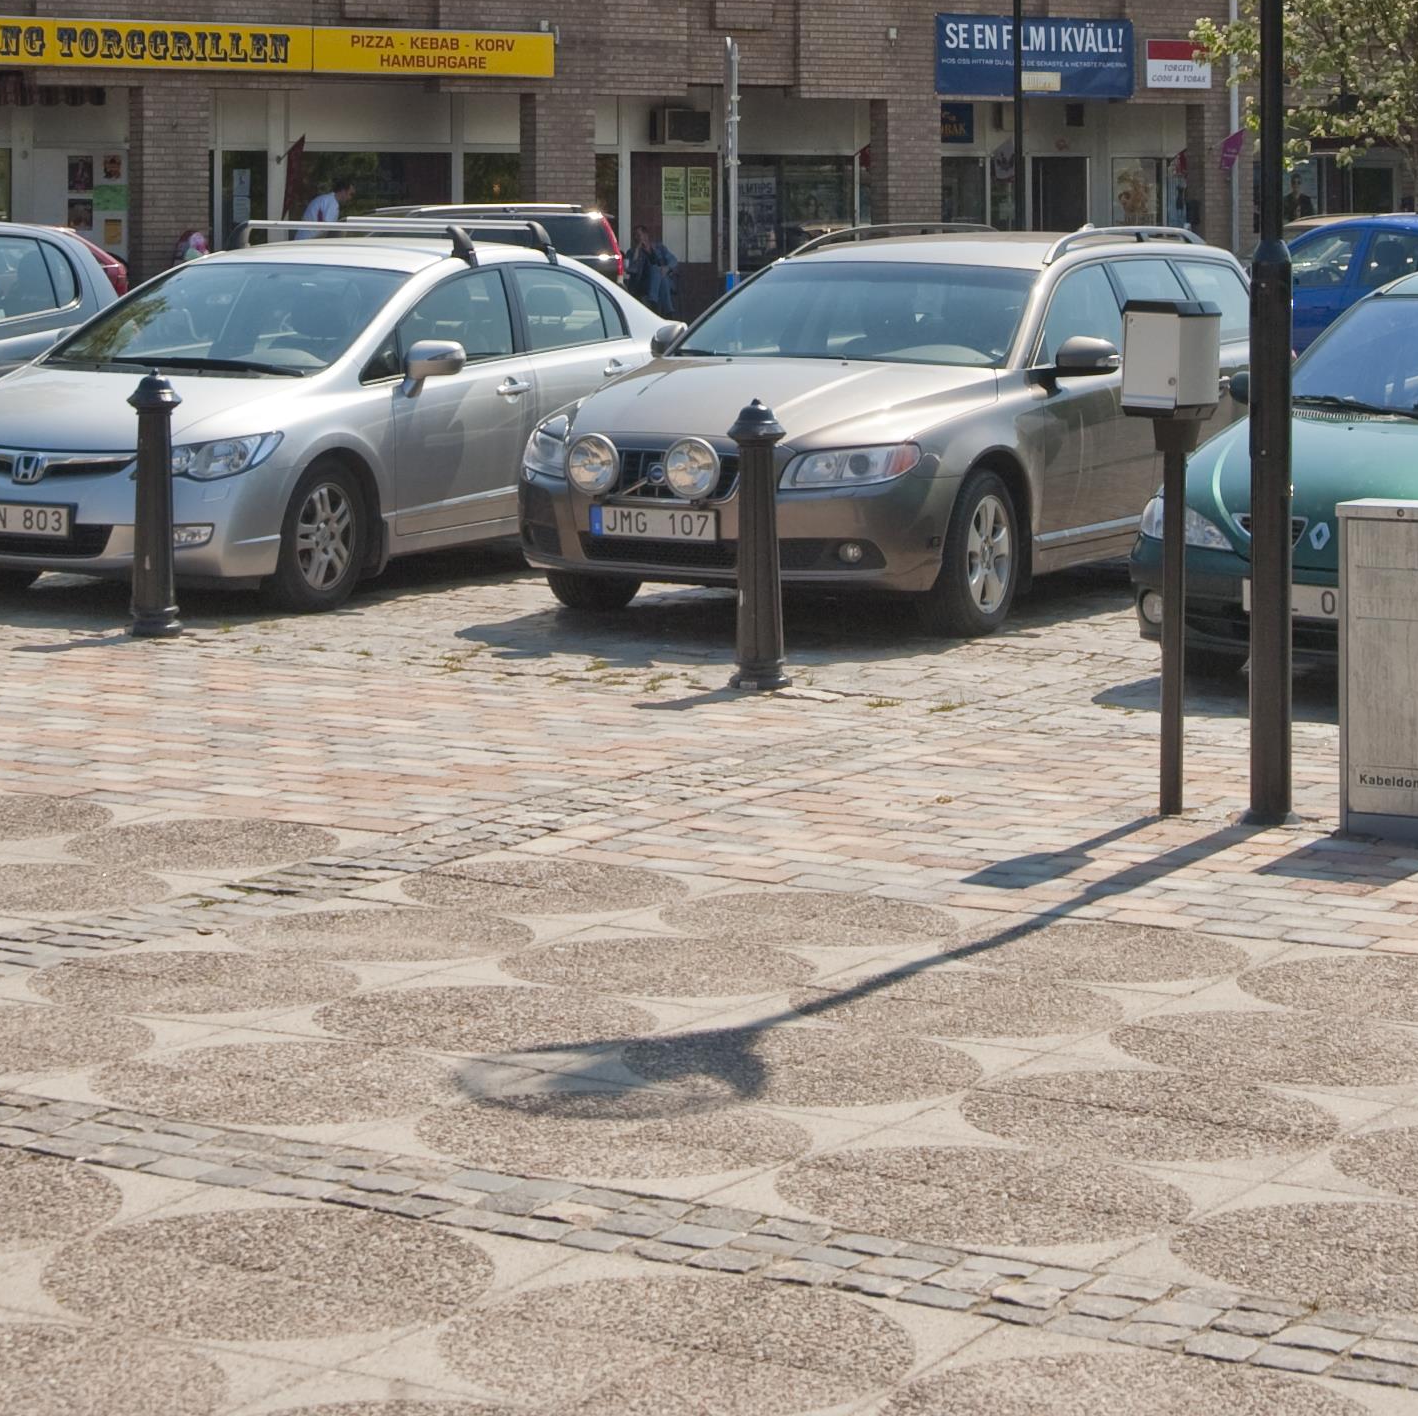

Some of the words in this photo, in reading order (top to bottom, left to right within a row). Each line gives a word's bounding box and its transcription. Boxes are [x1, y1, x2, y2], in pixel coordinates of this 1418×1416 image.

[56, 26, 291, 63] TORGGRILLEN
[350, 35, 395, 49] PIZZA
[410, 36, 460, 51] KEBAB
[475, 38, 515, 52] KORV
[945, 22, 969, 49] SE
[973, 24, 998, 50] EN
[1002, 25, 1046, 51] FLM
[1050, 27, 1056, 52] I
[1061, 23, 1124, 53] KVÄLL!
[380, 54, 487, 70] HAMBURGARE
[1183, 75, 1207, 84] TOBAK
[22, 509, 62, 532] 803
[606, 509, 648, 534] JMG
[668, 513, 709, 537] 107
